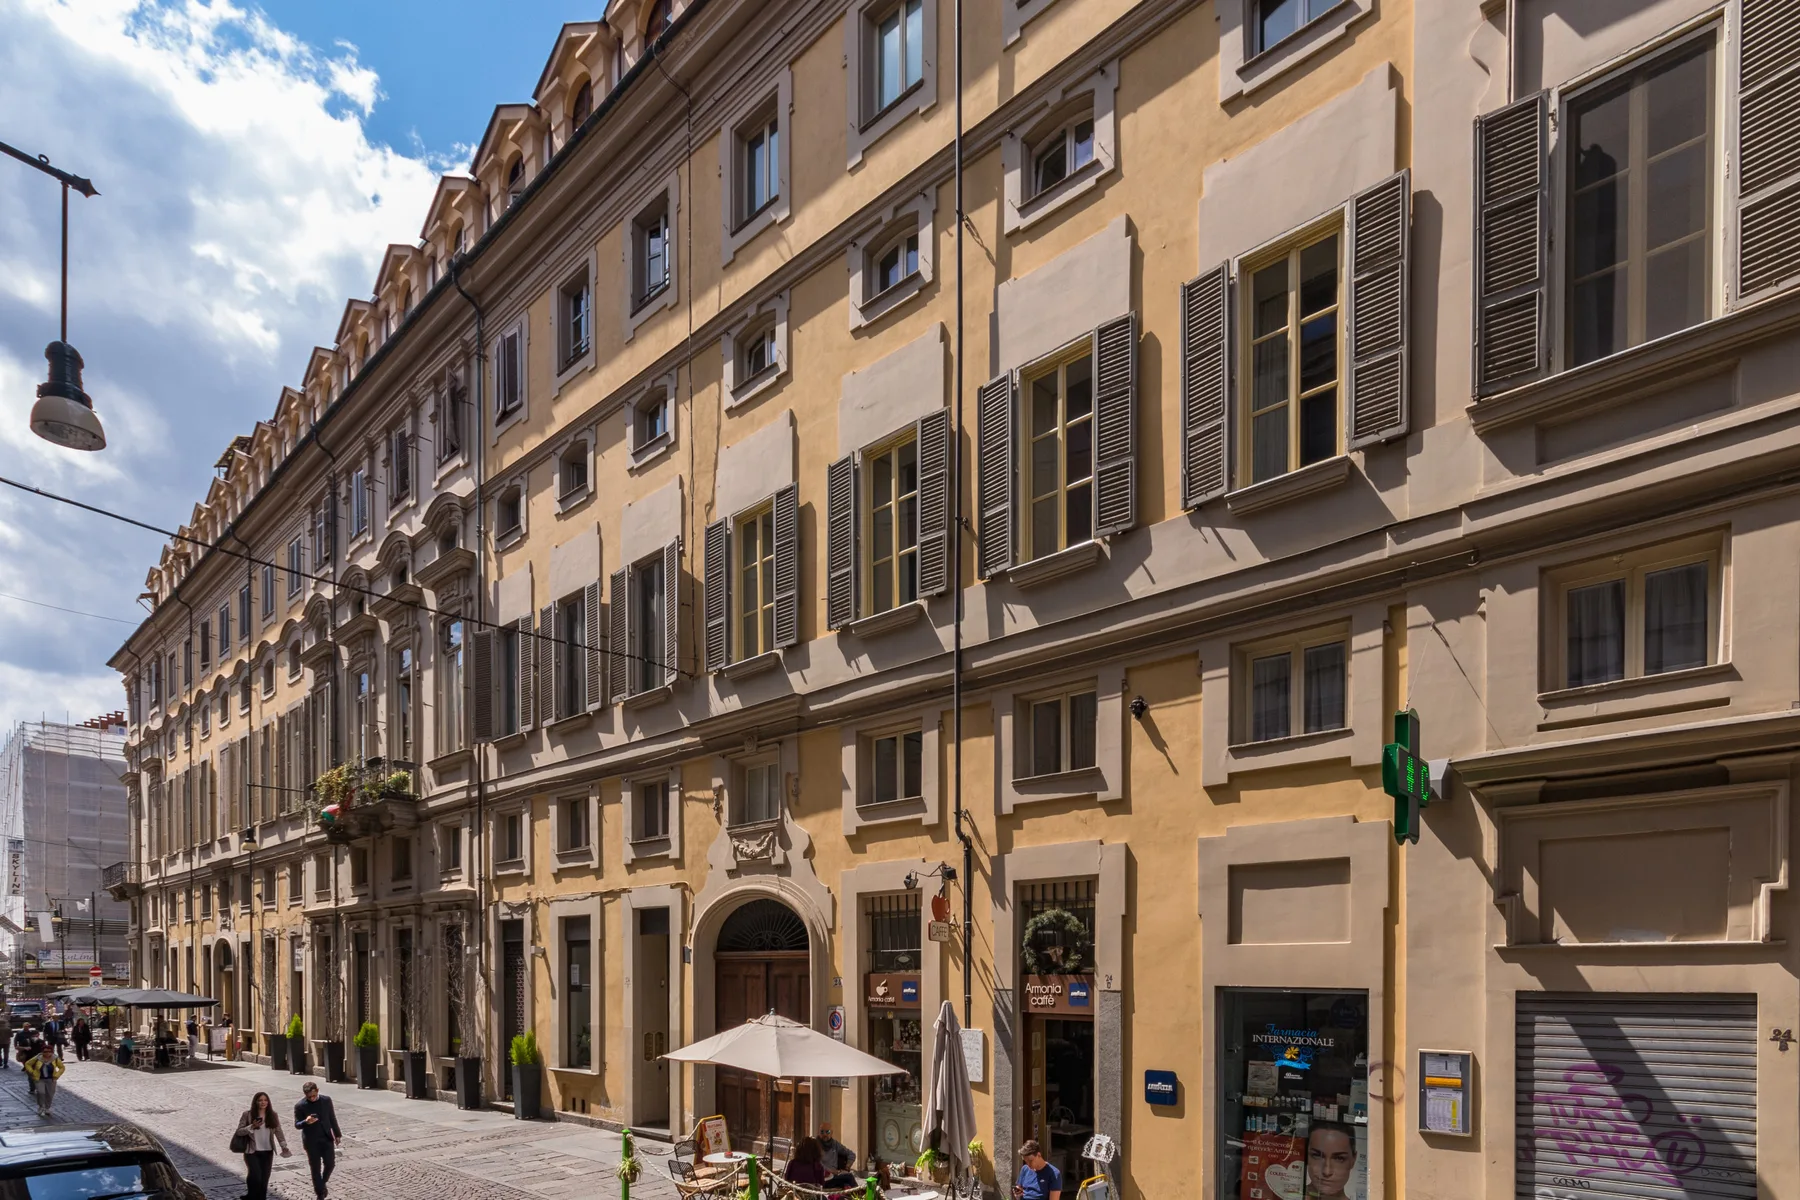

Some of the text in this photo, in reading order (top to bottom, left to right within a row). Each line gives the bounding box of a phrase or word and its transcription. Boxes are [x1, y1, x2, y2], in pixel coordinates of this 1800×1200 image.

[11, 853, 21, 895] SKYLINE
[1025, 983, 1062, 994] Armonia
[1030, 995, 1055, 1006] caffè
[1266, 1023, 1319, 1037] Farmacia
[1772, 1028, 1792, 1041] 24
[1252, 1034, 1335, 1047] INTERNAZIONALE
